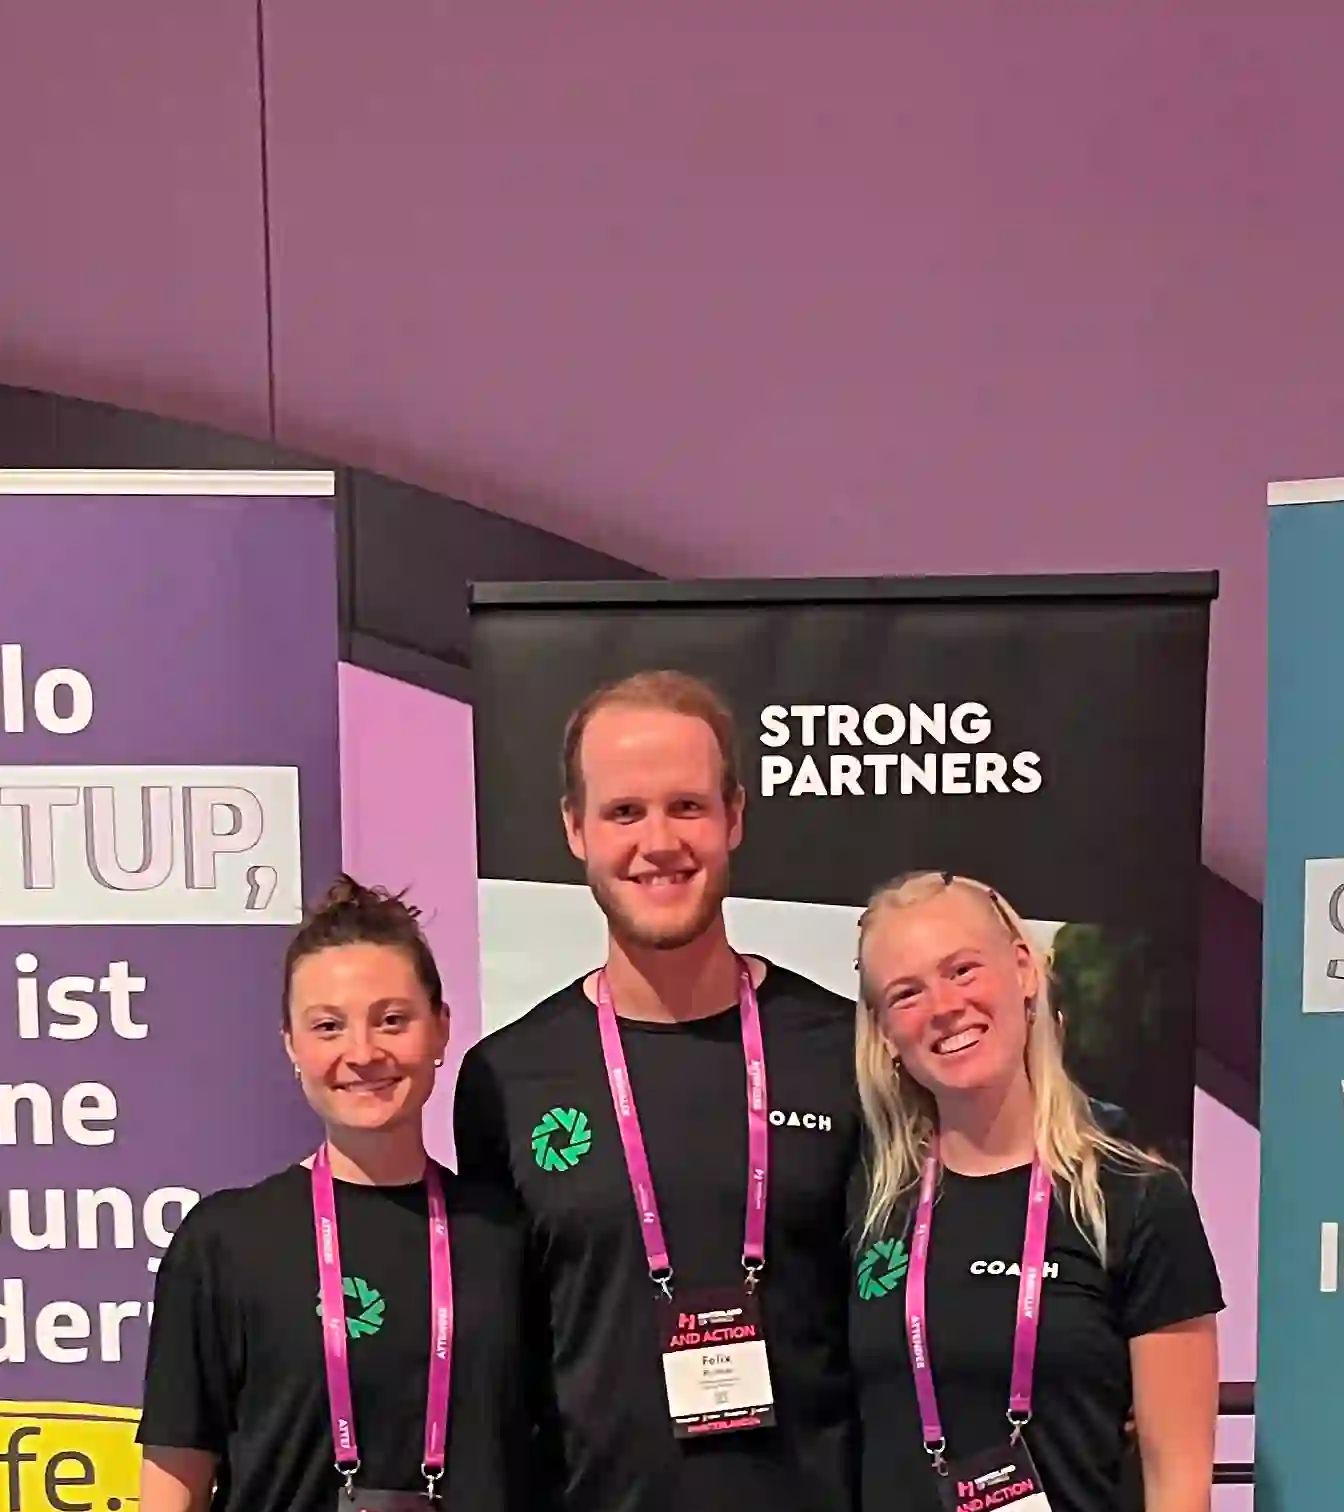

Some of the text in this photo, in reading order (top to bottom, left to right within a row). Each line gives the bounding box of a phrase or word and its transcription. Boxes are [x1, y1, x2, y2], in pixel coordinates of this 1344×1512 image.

[759, 702, 993, 748] STRONG
[759, 750, 1044, 797] PARTNERS
[15, 953, 148, 1041] ist
[769, 1109, 833, 1133] OACH
[969, 1259, 1059, 1280] COAH
[669, 1324, 756, 1347] AND ACTION
[984, 1477, 1035, 1508] ACTION
